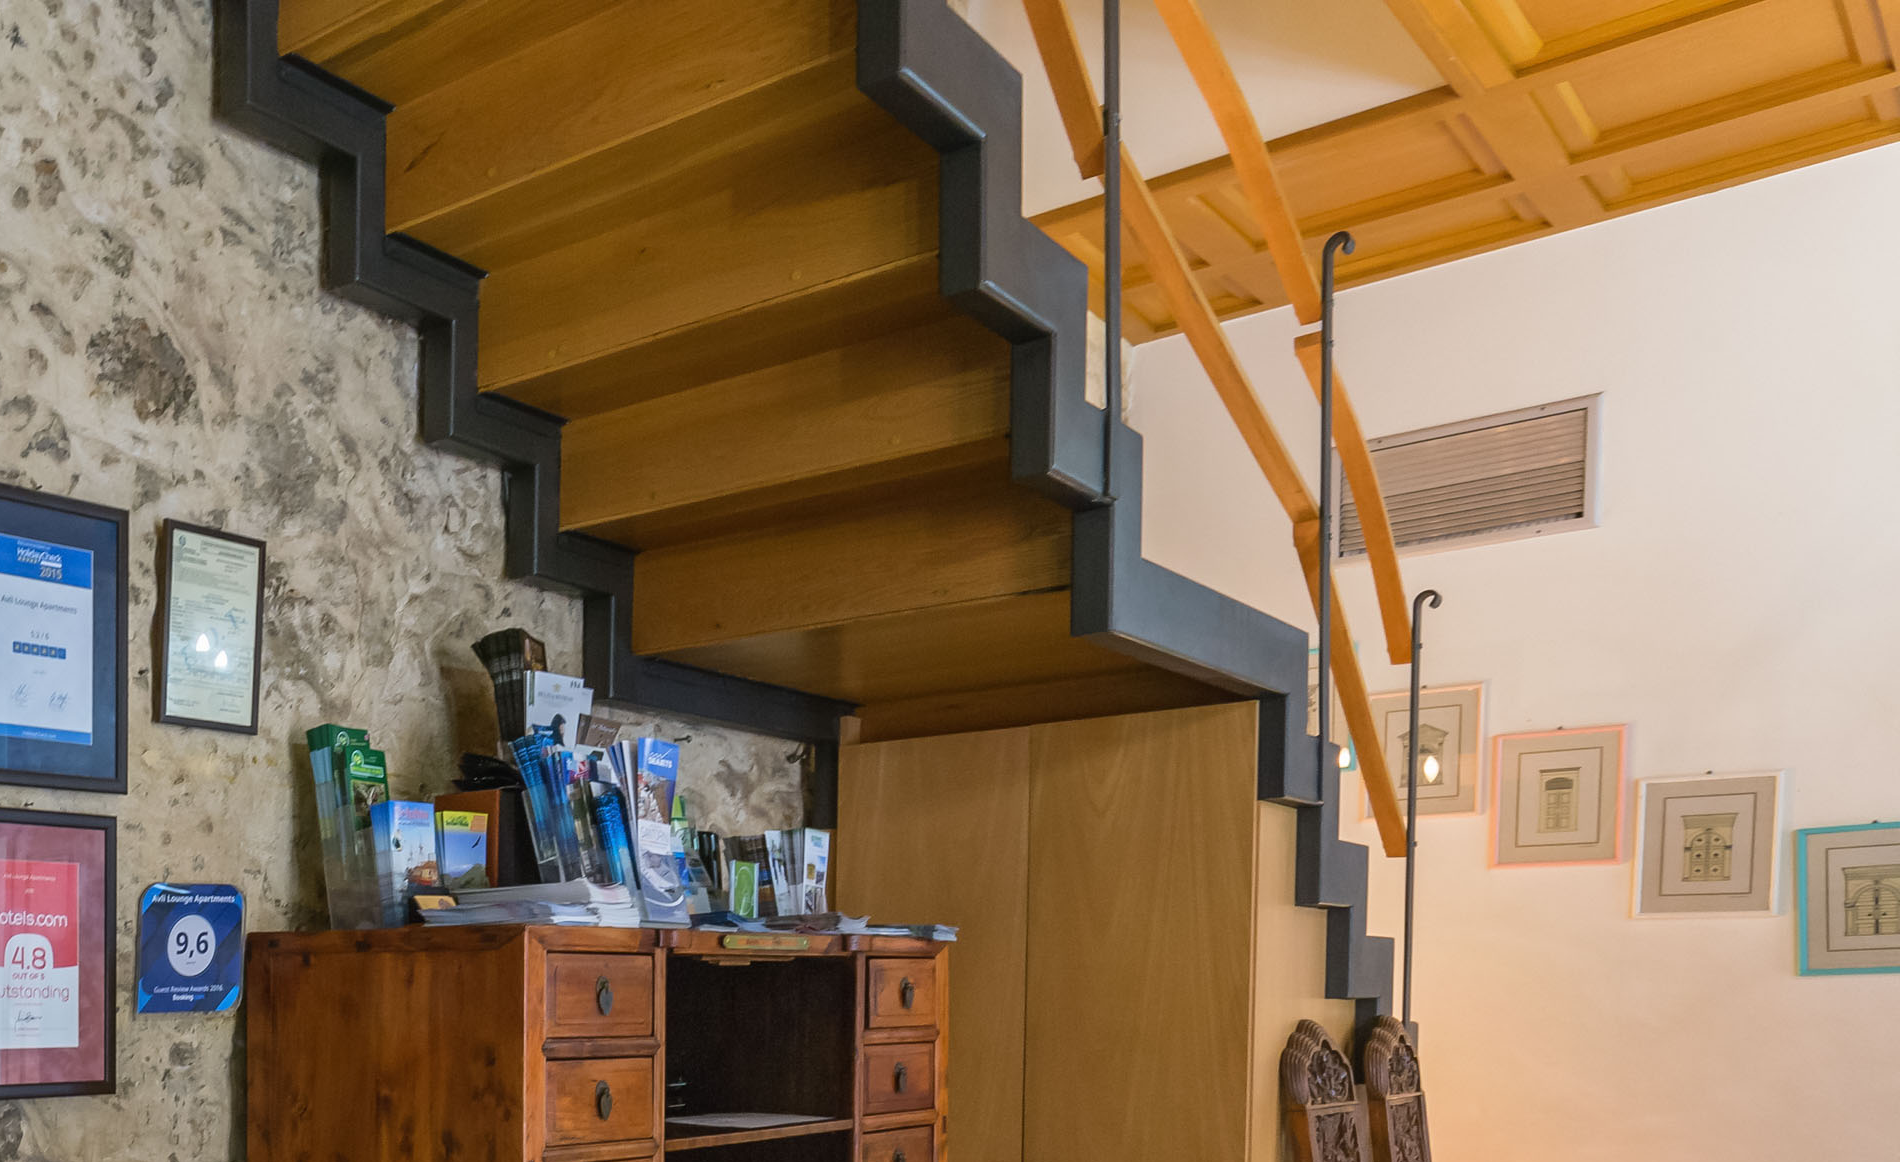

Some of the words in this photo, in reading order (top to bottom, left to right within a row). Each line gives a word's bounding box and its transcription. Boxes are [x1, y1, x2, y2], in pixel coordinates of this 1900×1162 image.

[167, 895, 194, 905] Lounge
[194, 895, 235, 904] Apartments
[176, 932, 208, 958] 9,6
[12, 946, 46, 970] 4.8
